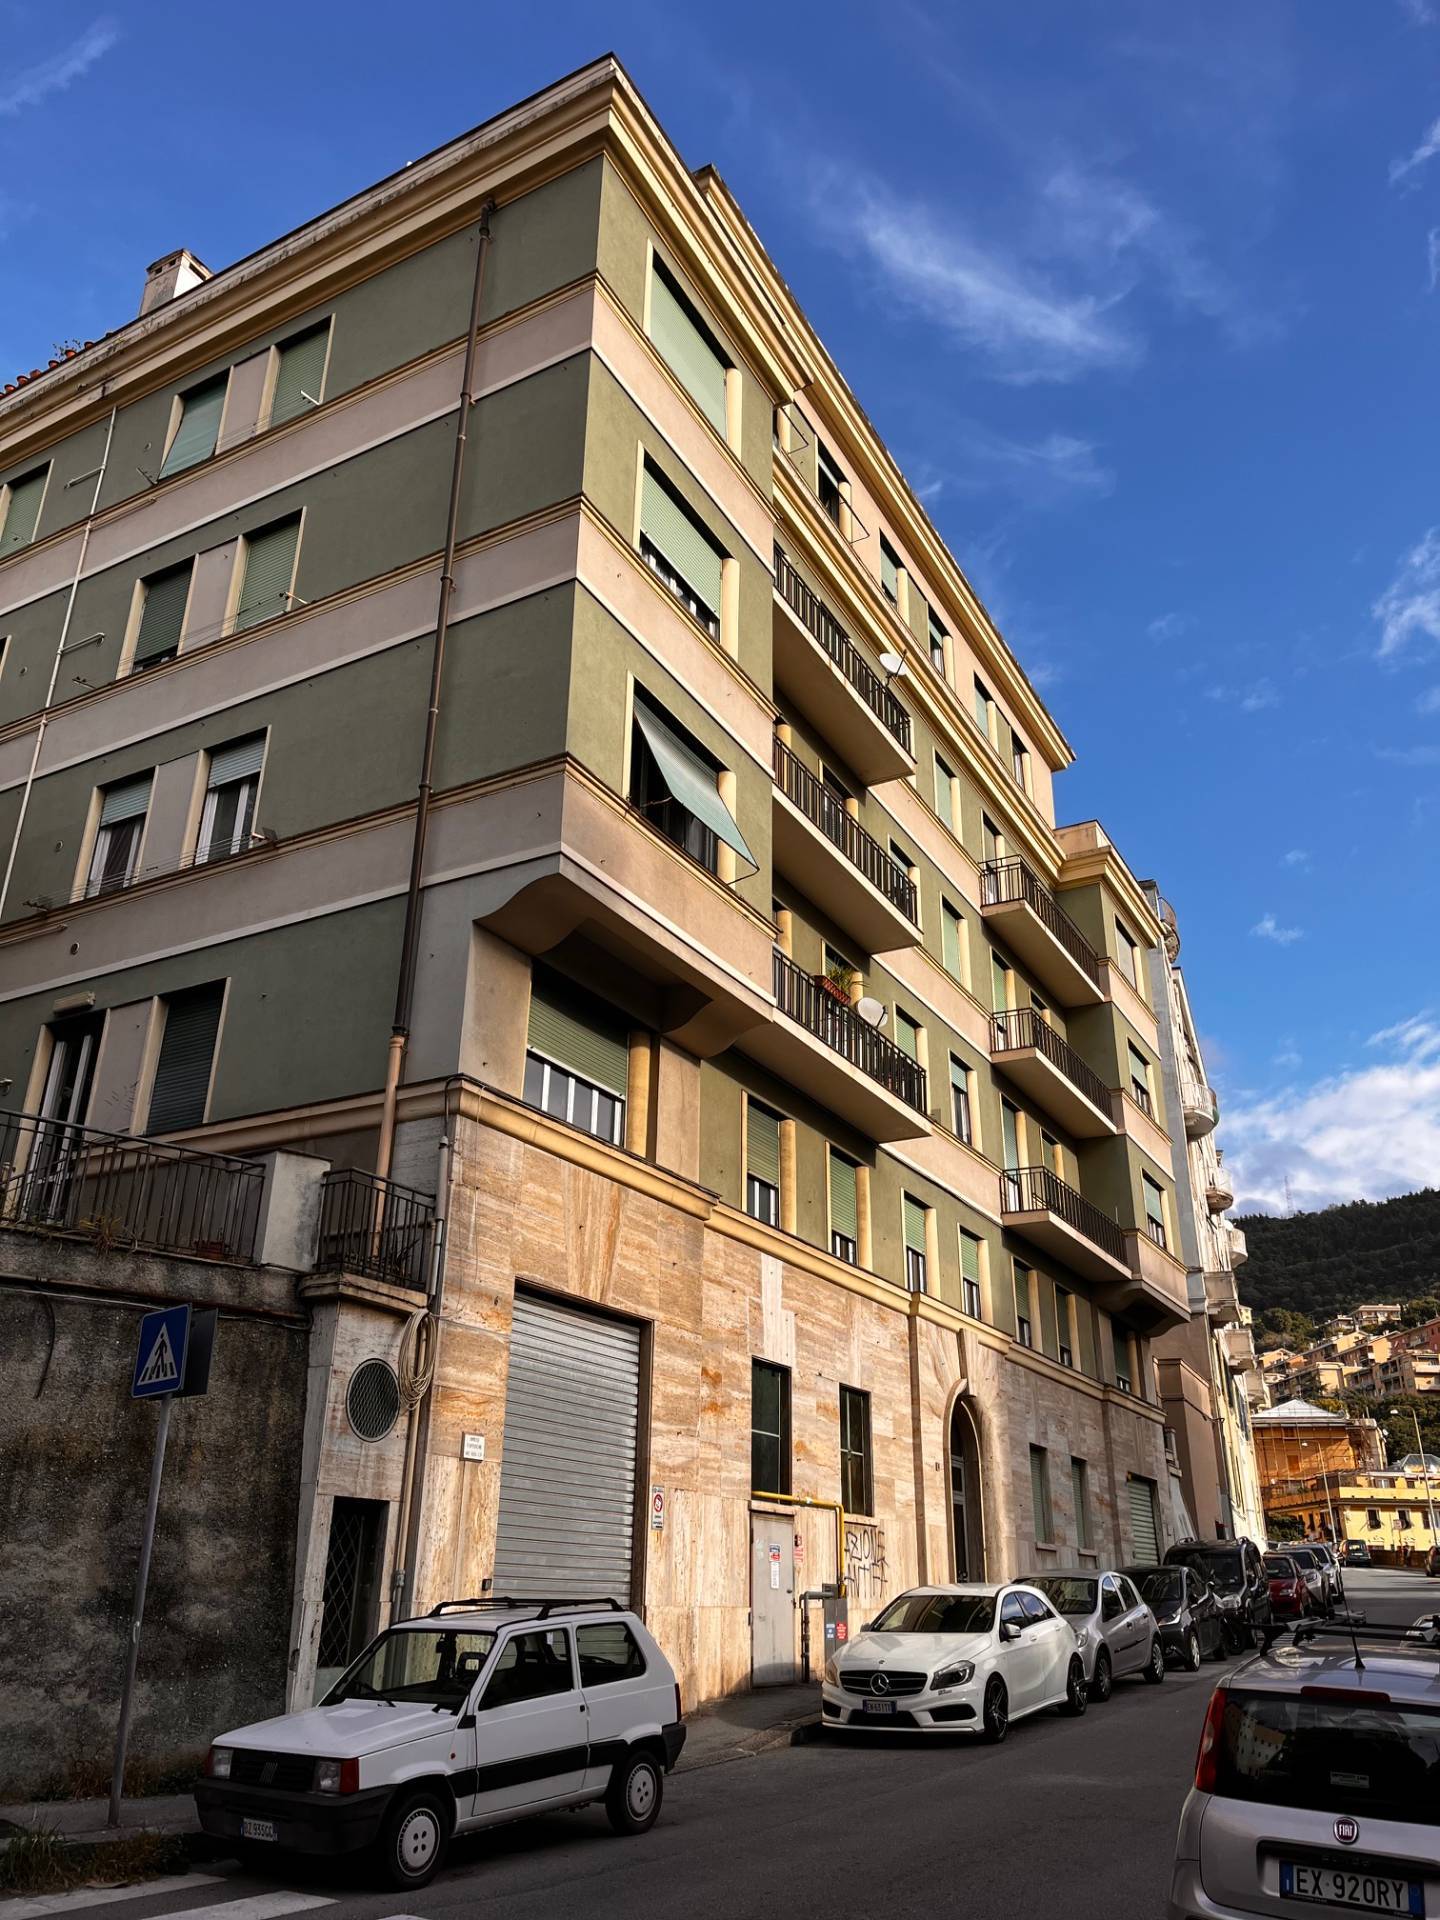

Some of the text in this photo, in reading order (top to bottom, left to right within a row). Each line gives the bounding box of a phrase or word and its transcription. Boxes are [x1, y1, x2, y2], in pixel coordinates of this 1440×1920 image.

[844, 1563, 888, 1598] ANTIFA
[1338, 1823, 1353, 1838] FIAT
[1296, 1868, 1323, 1896] EX
[1333, 1873, 1404, 1908] 920RY
